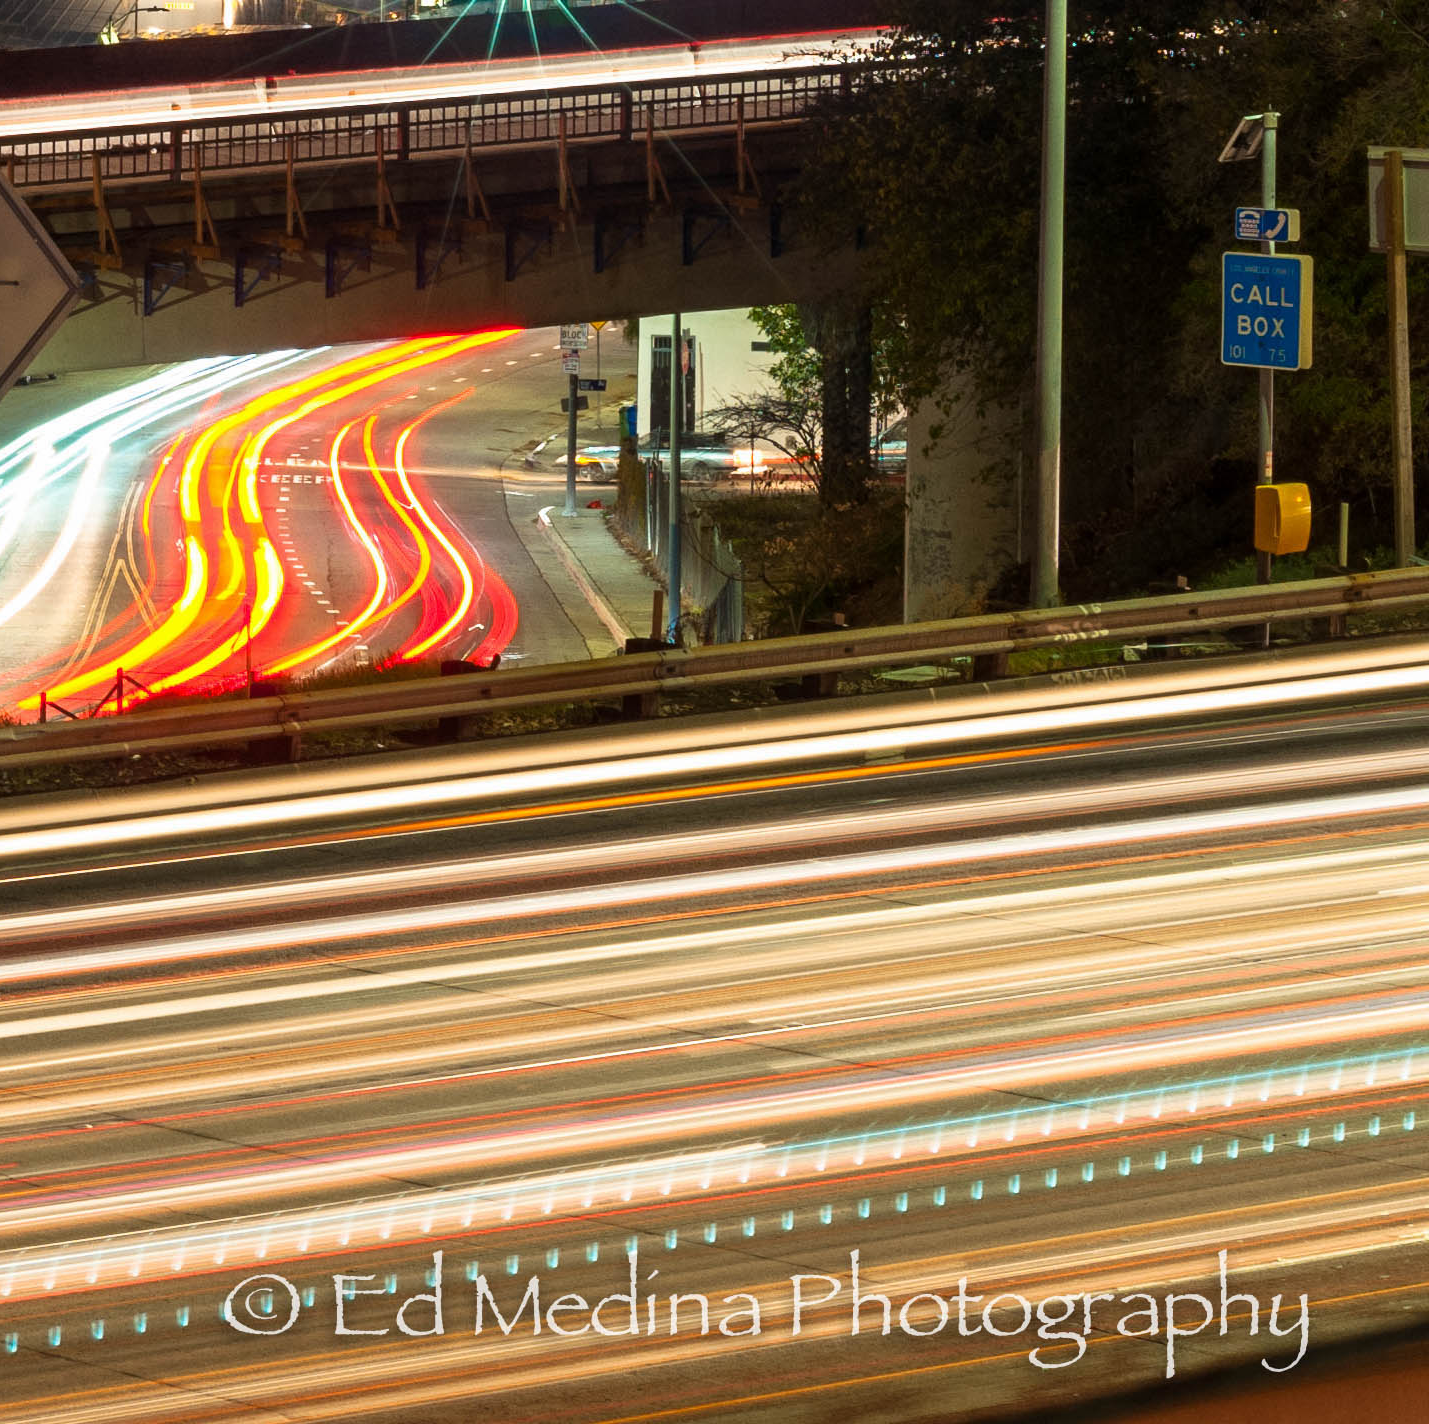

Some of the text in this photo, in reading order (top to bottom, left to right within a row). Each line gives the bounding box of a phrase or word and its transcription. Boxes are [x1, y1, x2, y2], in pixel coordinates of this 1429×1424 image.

[1230, 283, 1294, 307] CALL
[1237, 315, 1285, 338] BOX
[1229, 344, 1246, 359] 101
